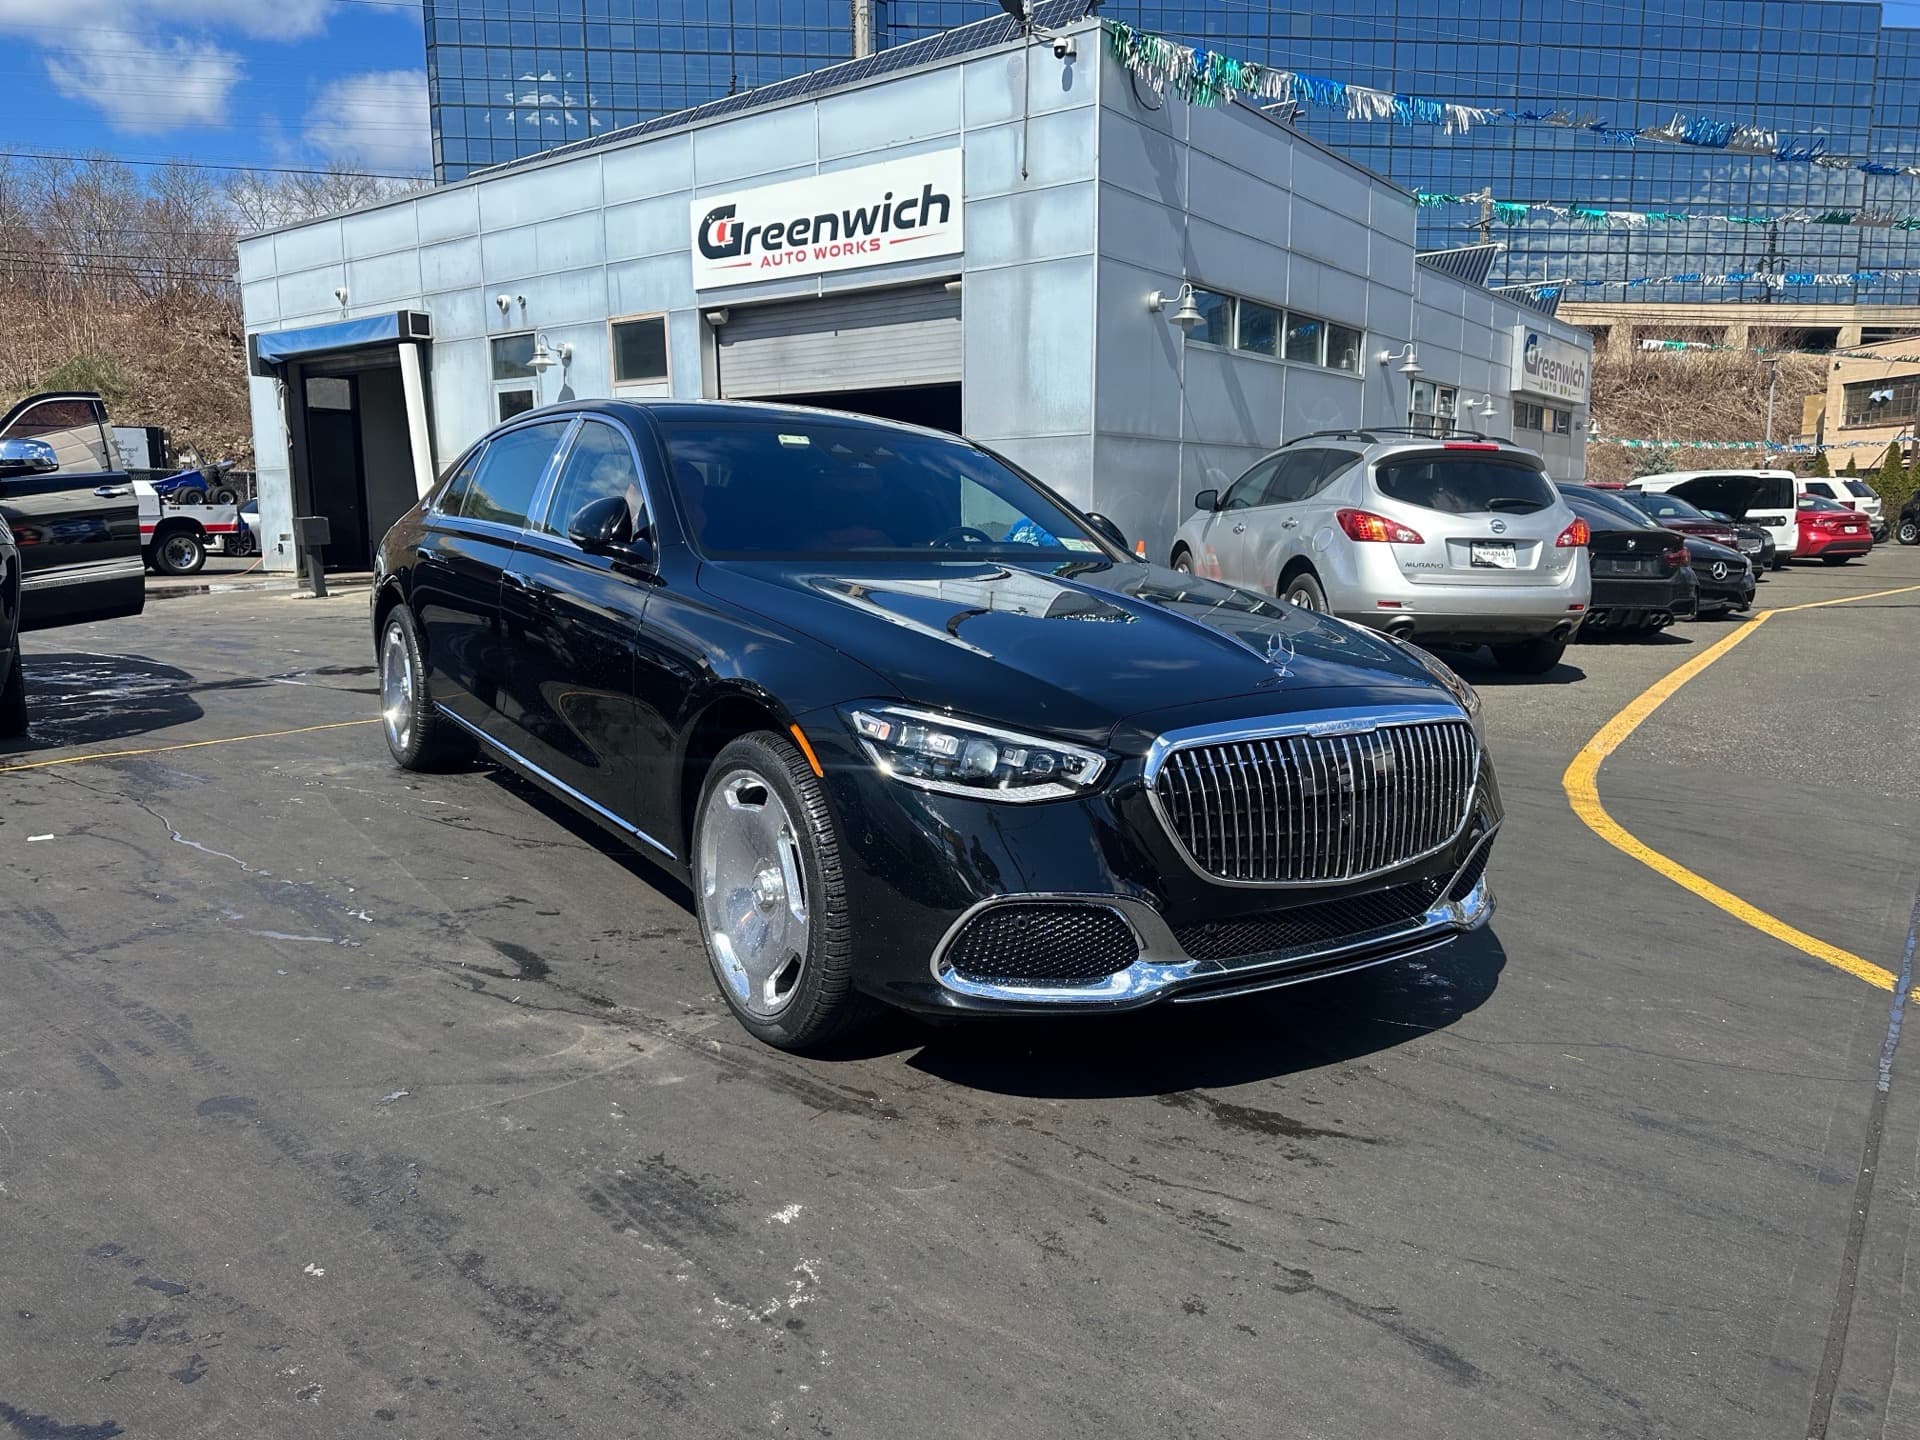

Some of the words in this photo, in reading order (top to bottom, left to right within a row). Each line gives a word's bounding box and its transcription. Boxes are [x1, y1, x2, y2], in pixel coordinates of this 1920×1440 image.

[698, 184, 950, 259] Greenwich
[760, 250, 807, 268] AUTO
[814, 238, 881, 260] WORKS
[1525, 333, 1585, 389] Greenwich
[1539, 380, 1557, 393] AUTO
[1404, 561, 1444, 569] MURANO
